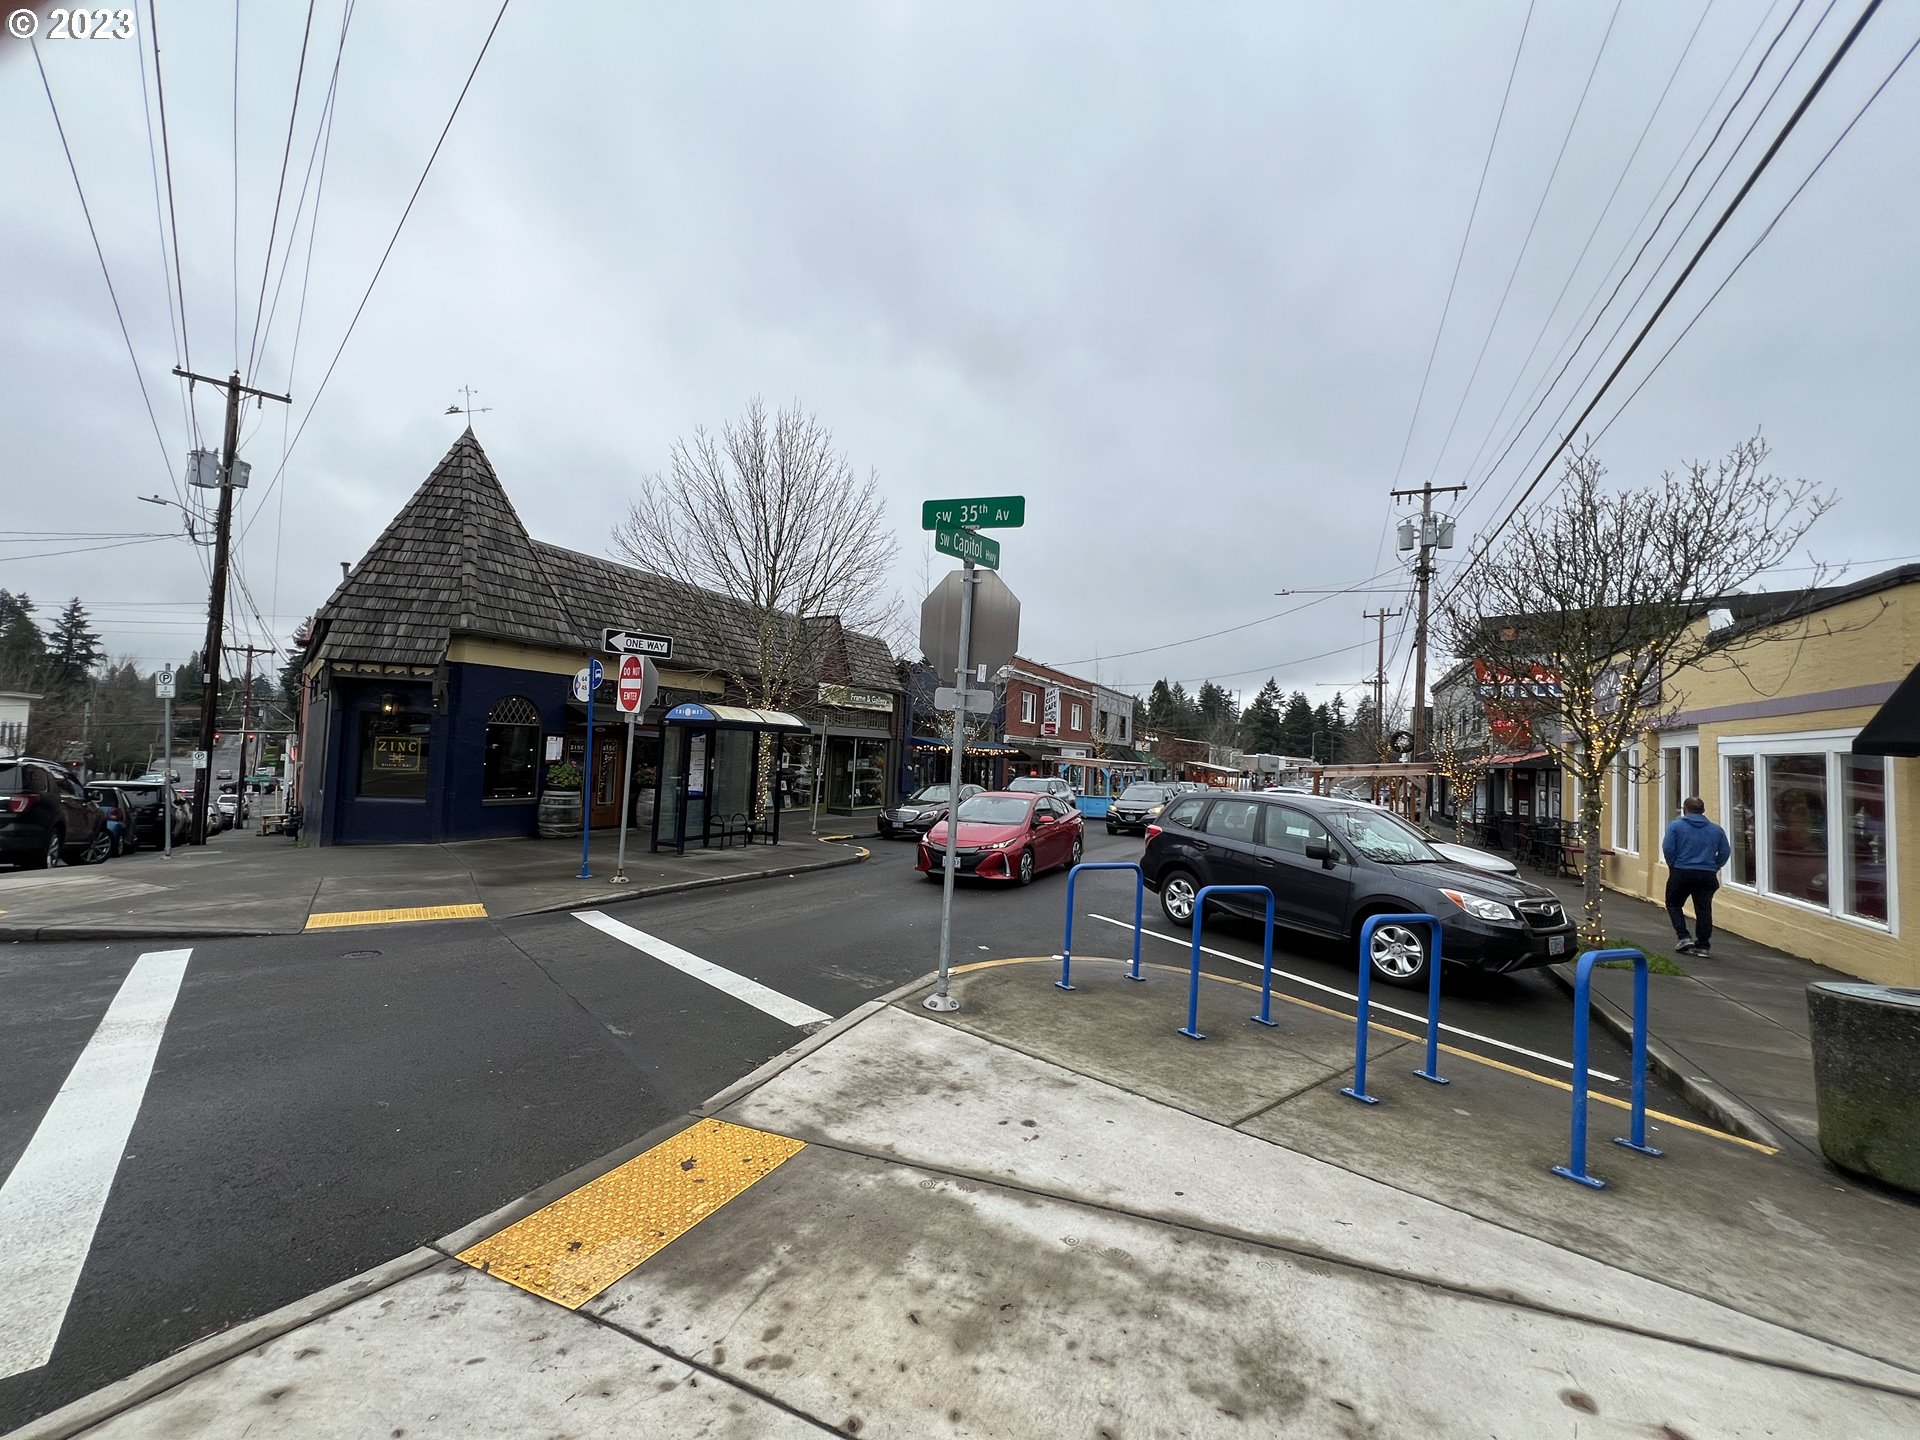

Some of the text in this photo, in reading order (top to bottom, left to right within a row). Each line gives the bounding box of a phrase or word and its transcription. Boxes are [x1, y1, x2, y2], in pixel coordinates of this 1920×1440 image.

[935, 504, 1010, 523] SW 35th Av
[939, 532, 997, 566] SW Capitol Hwy
[625, 638, 666, 651] ONE WAY
[623, 667, 641, 676] DO NOT
[623, 691, 638, 701] ENTER
[850, 692, 866, 703] Frame
[1045, 695, 1056, 705] CITY
[378, 741, 417, 752] ZINC
